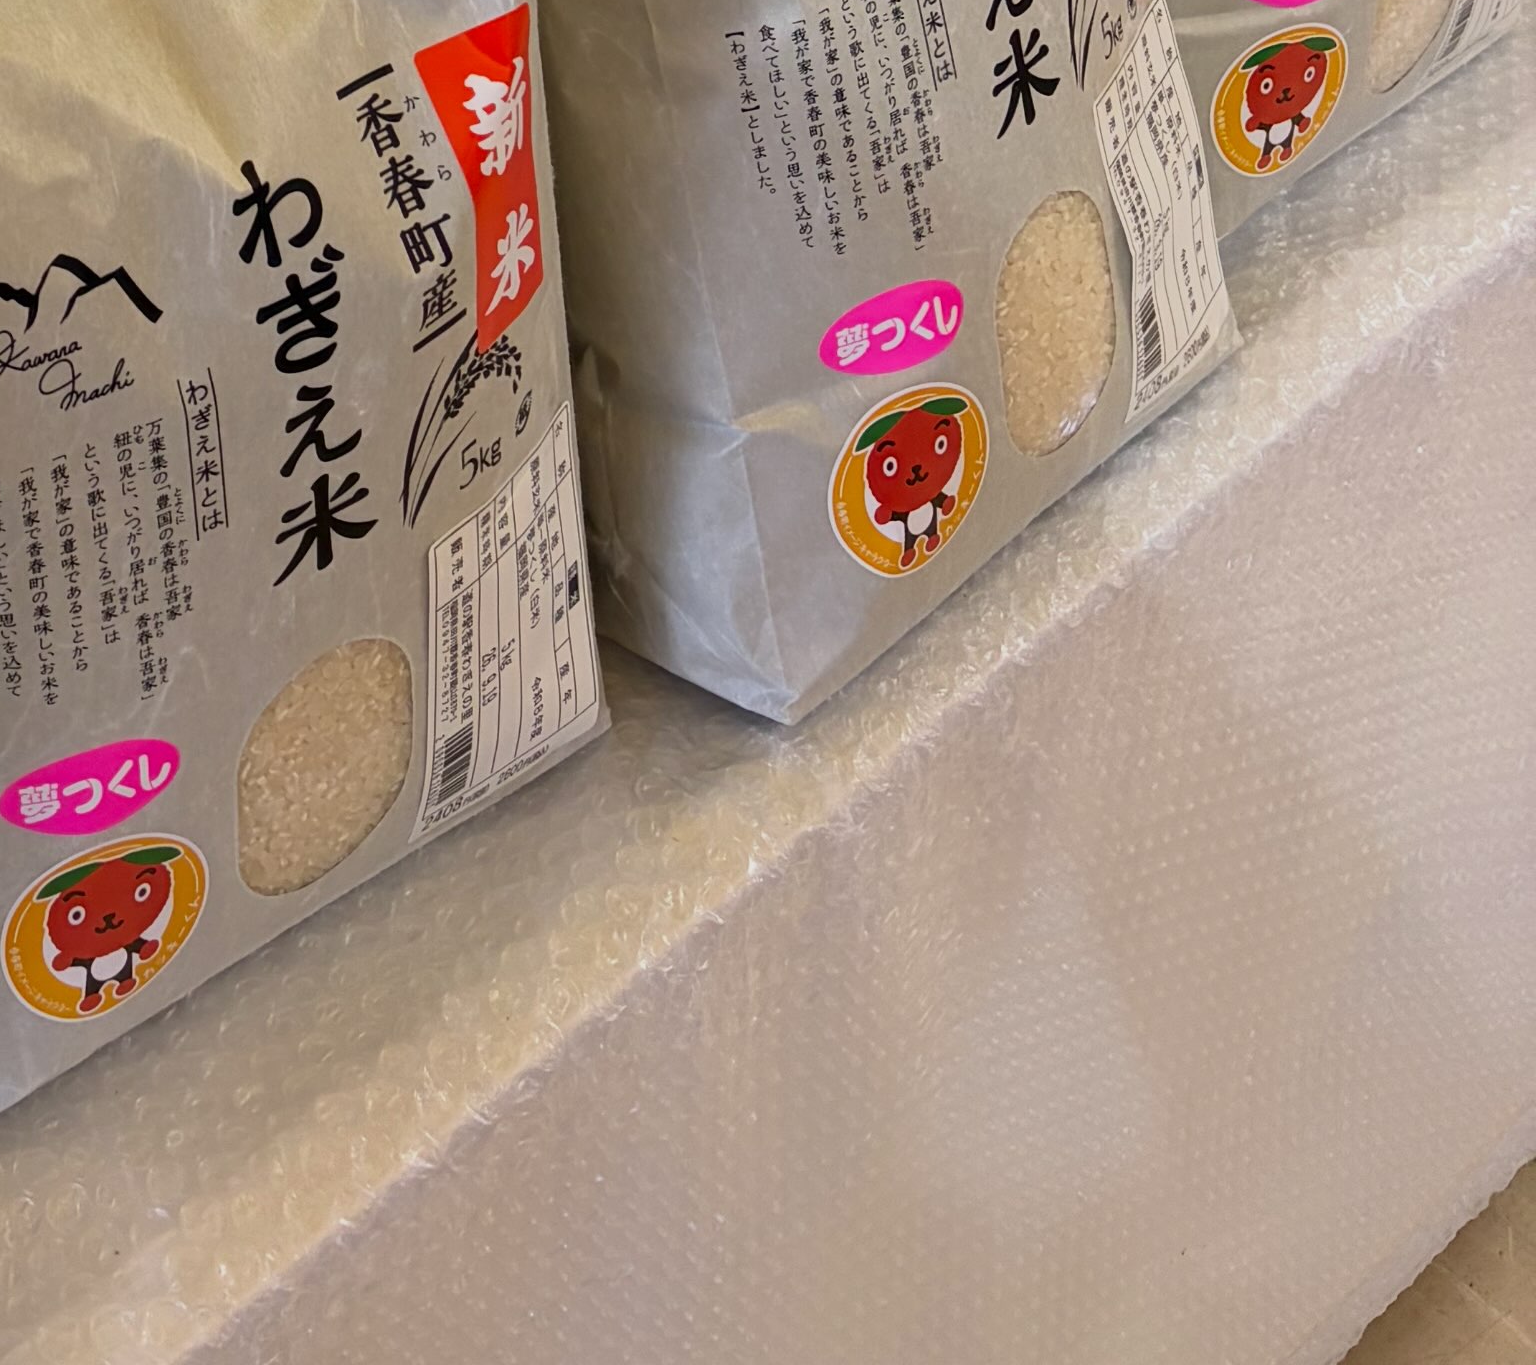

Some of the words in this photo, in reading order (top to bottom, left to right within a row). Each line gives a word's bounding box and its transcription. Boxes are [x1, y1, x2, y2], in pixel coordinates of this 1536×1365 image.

[759, 26, 814, 248] 食べてほしい」という思いを込めて
[1101, 14, 1125, 62] 5kg
[356, 94, 461, 332] 香春町産
[463, 56, 535, 315] 新米
[232, 160, 378, 586] わぎえ米
[835, 296, 958, 367] 夢つくし
[84, 443, 121, 644] という歌に出てくる「吾家」は
[186, 380, 224, 531] わぎえ米とは
[460, 437, 503, 490] 5kg
[18, 467, 59, 705] 「我が家で香春町の美味しいお米を
[51, 454, 88, 671] 「我が家」の意味であることから
[18, 754, 171, 824] 夢つくし
